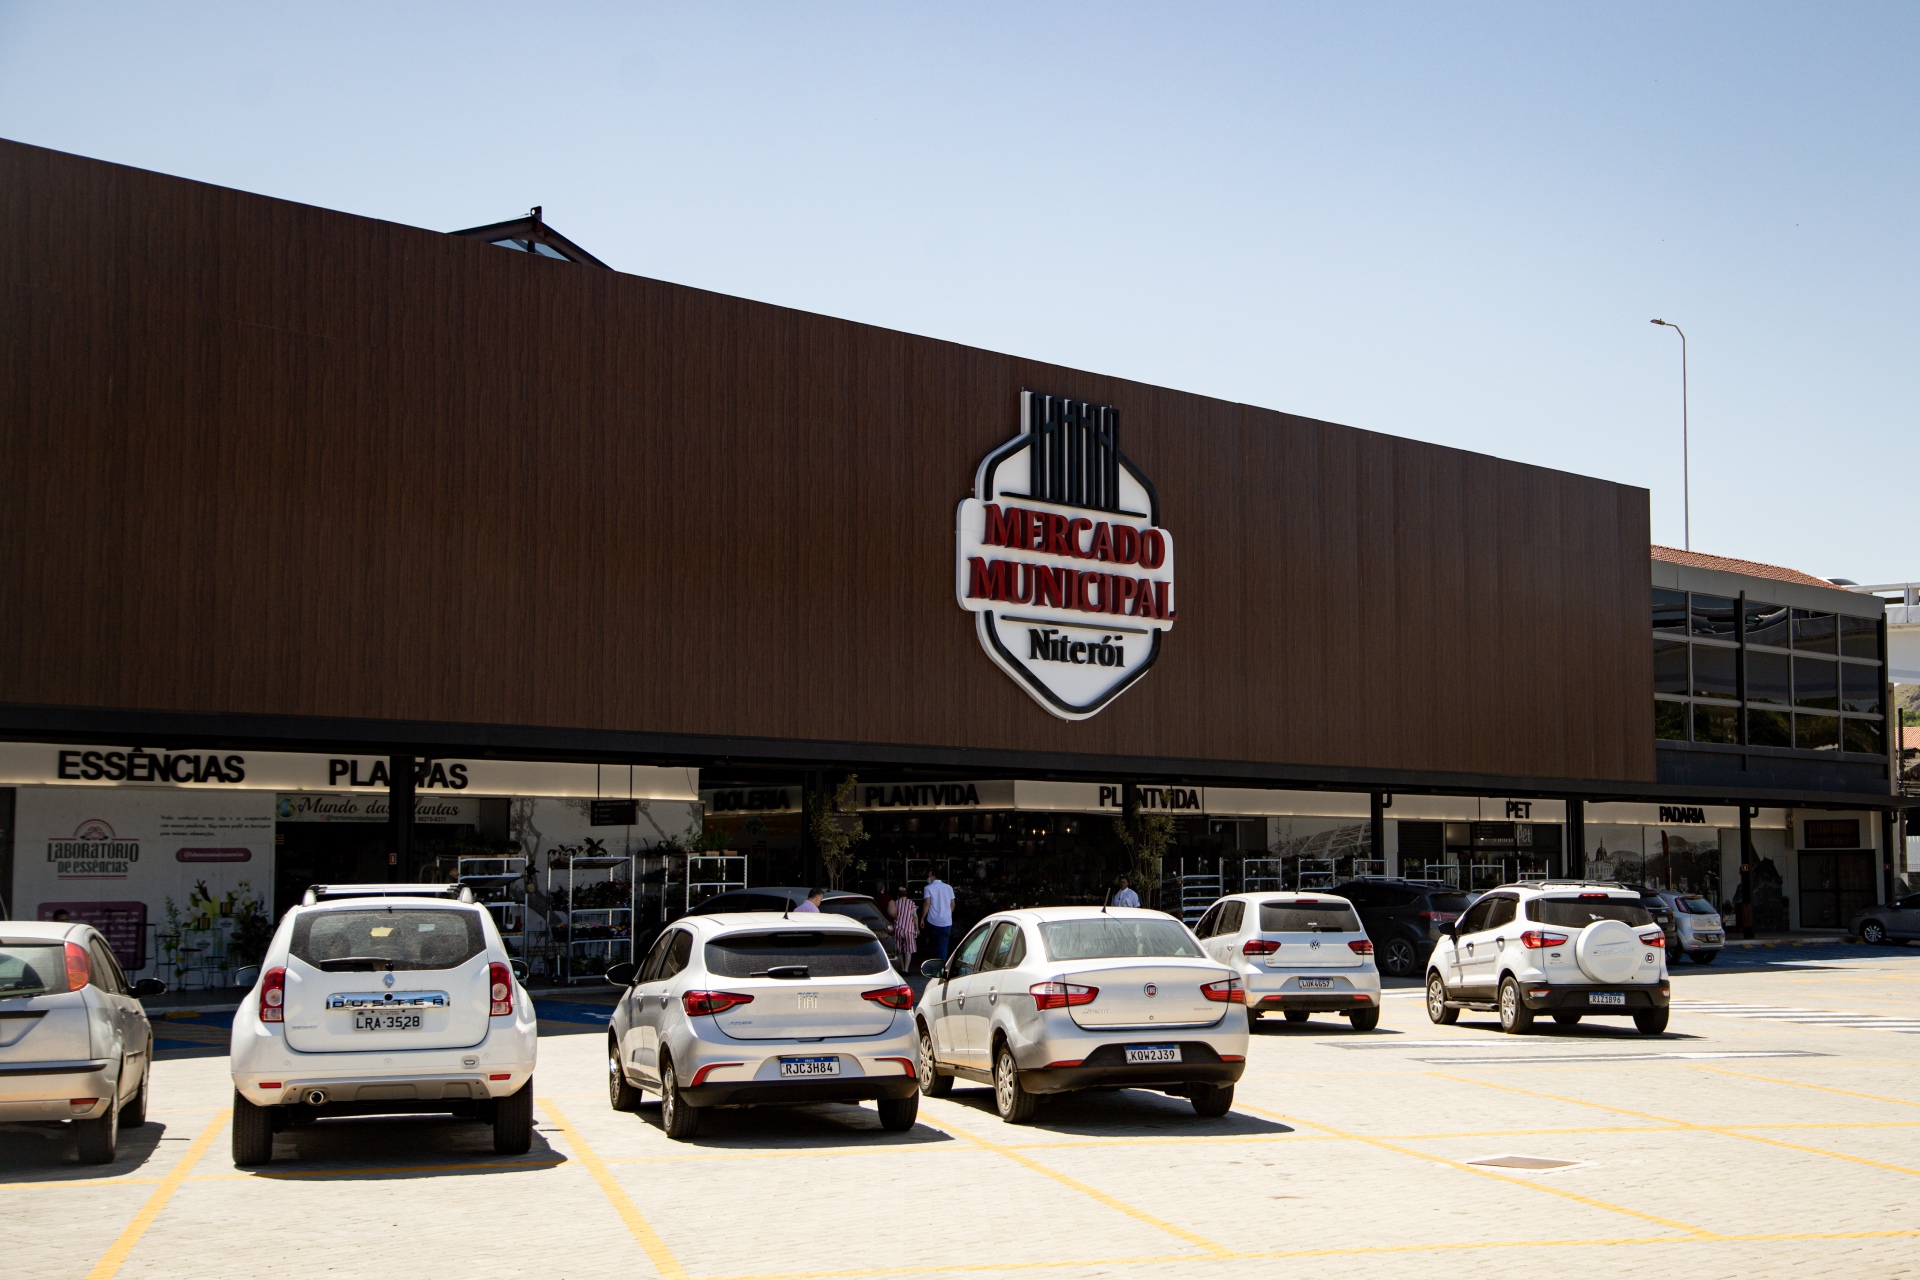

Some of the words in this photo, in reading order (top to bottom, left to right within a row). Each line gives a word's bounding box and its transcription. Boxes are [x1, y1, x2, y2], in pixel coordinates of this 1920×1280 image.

[981, 503, 1166, 569] MERCADO
[966, 556, 1178, 621] MUNICIPAL
[1029, 628, 1125, 667] Niterói
[58, 747, 245, 783] ESSÊNCIAS
[298, 796, 360, 814] Mundo
[866, 784, 980, 808] PLANTVIDA
[1099, 786, 1200, 809] PLNTVIDA
[1506, 801, 1532, 819] PET
[1659, 805, 1706, 823] PADARIA
[333, 999, 444, 1008] DUSTER
[786, 1062, 833, 1075] RJC3H84
